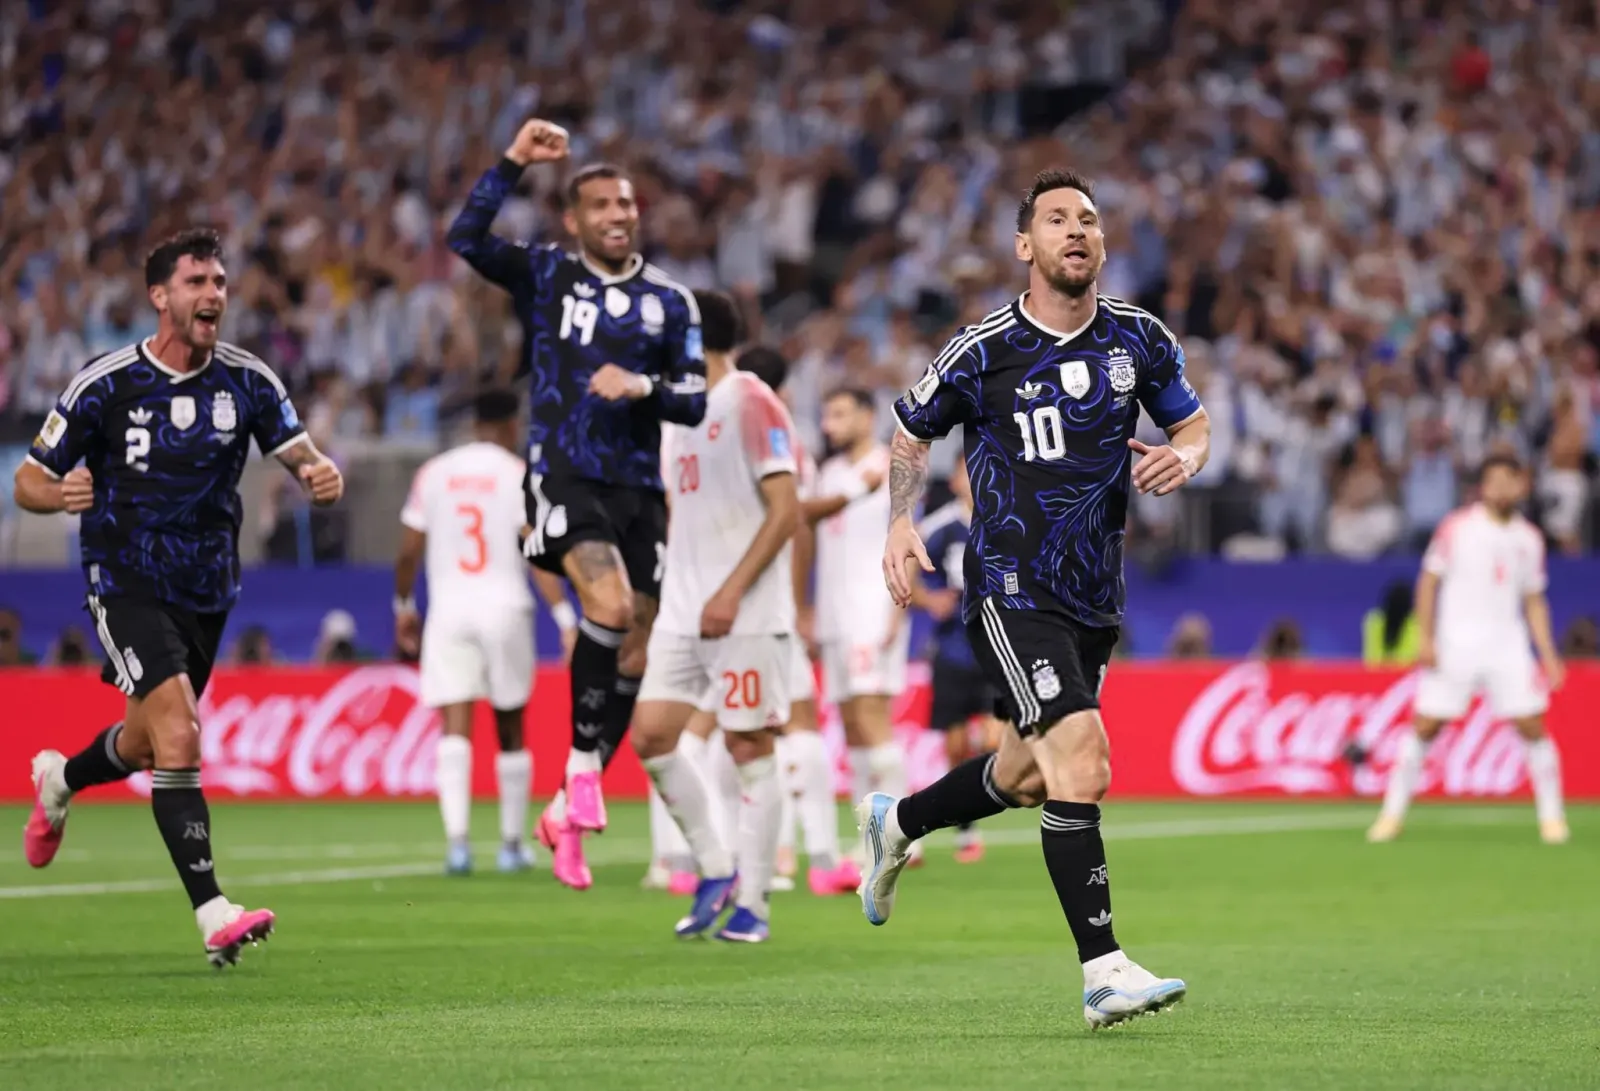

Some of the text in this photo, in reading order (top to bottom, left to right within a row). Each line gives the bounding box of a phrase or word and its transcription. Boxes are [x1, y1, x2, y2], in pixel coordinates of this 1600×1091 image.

[560, 296, 598, 346] 19
[125, 427, 150, 473] 2
[1013, 405, 1066, 461] 10
[456, 505, 488, 573] 3
[722, 670, 761, 709] 20
